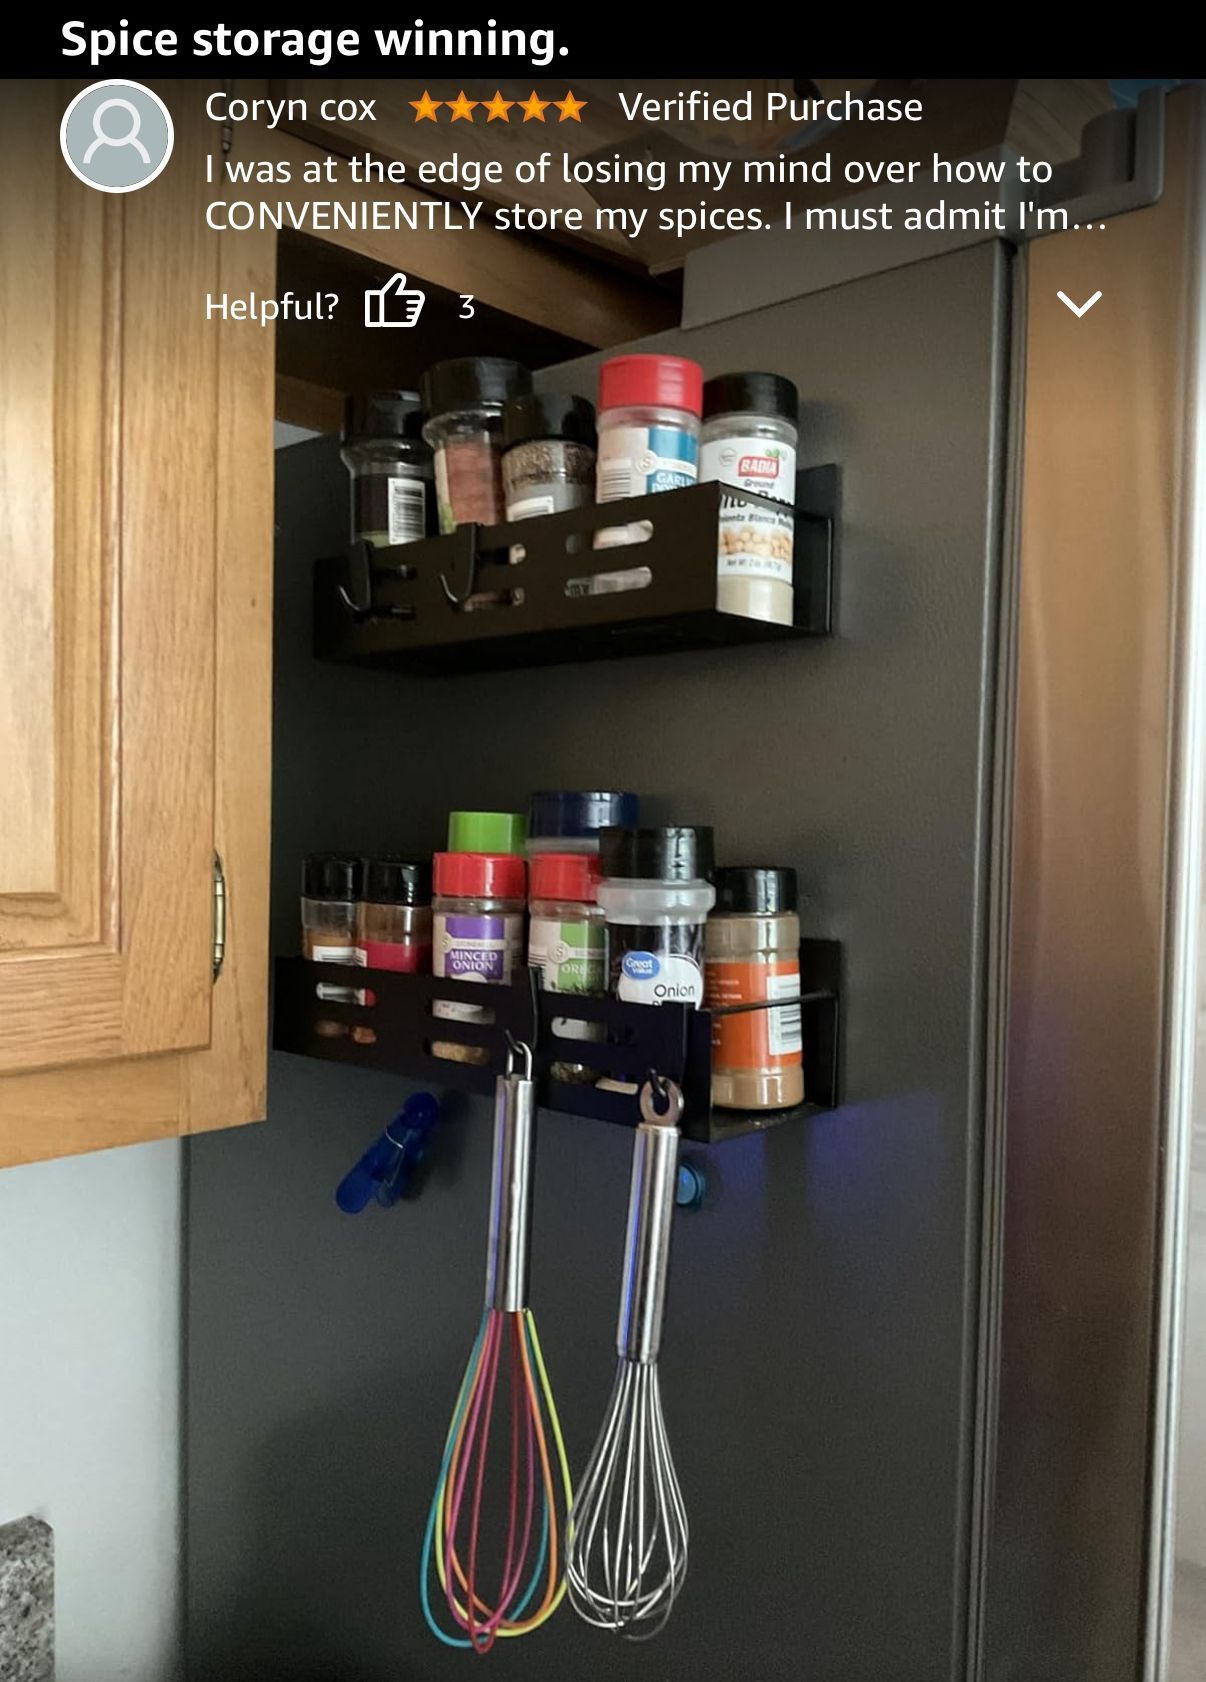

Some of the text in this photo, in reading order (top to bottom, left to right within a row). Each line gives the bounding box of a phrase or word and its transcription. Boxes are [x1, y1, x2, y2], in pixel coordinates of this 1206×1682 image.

[742, 459, 776, 474] BADIA
[450, 950, 498, 961] MINCED
[452, 960, 494, 971] ONION
[625, 957, 654, 969] Great
[654, 983, 695, 998] Onion
